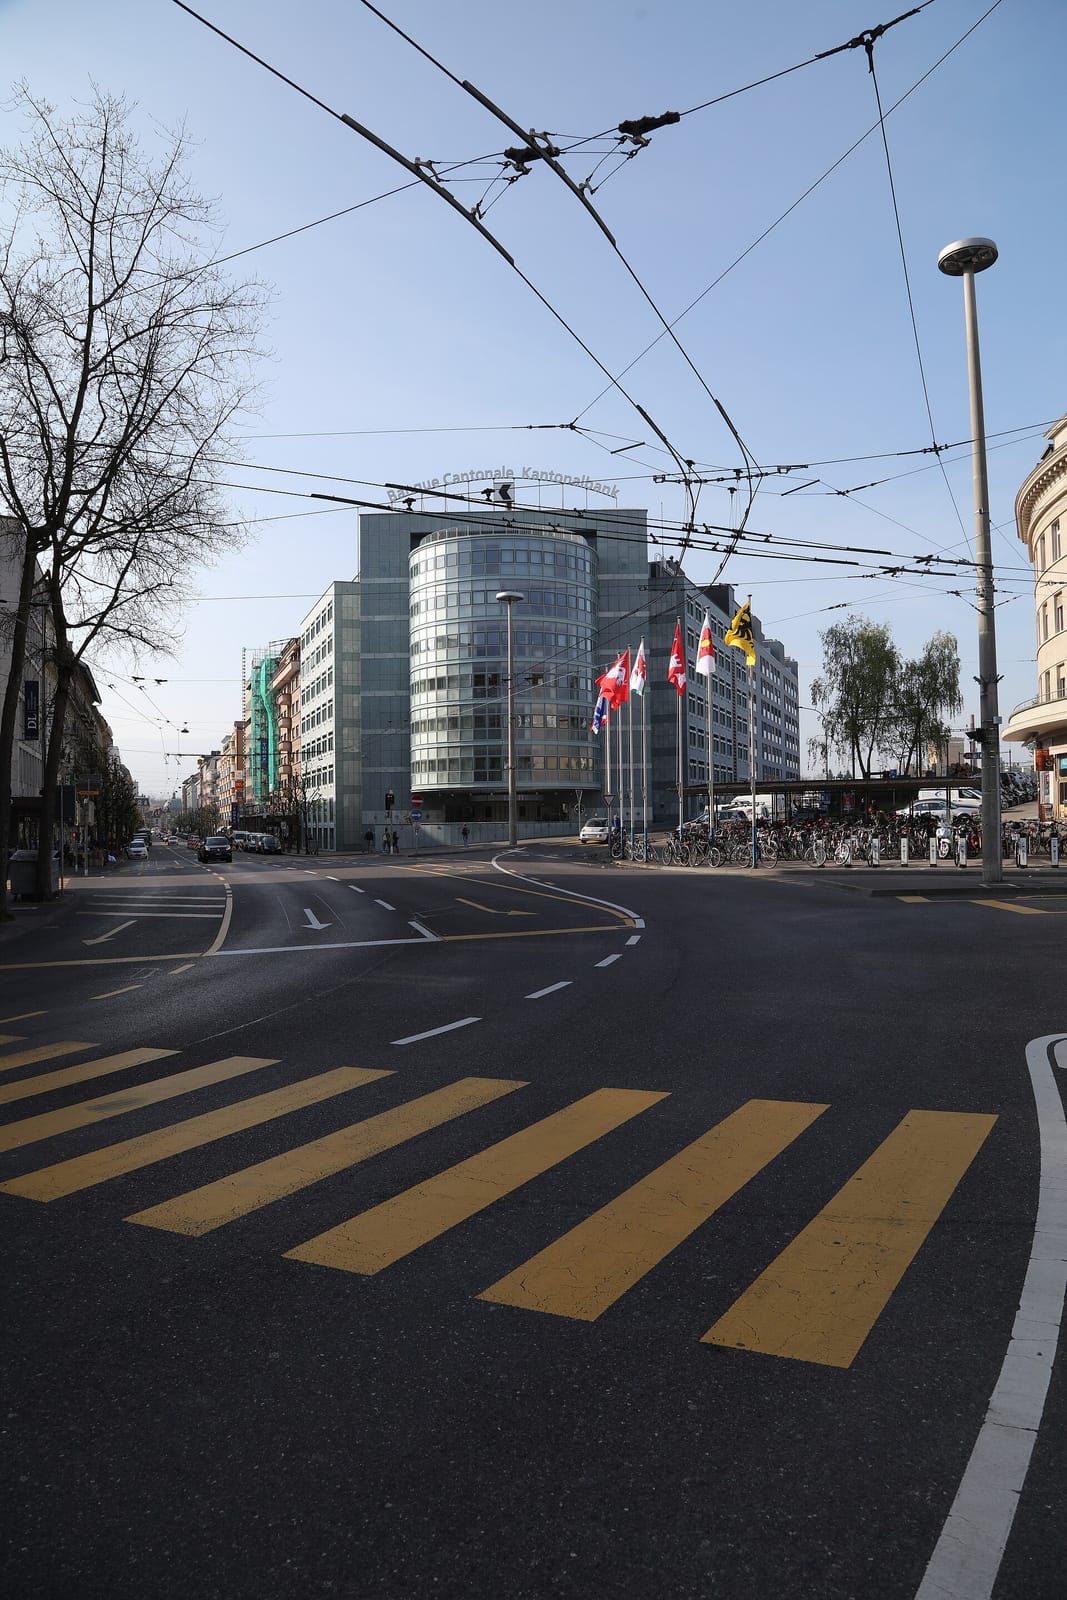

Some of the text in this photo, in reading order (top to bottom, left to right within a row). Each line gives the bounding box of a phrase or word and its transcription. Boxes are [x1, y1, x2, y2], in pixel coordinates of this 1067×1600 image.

[386, 465, 620, 501] Baque Cantonale Kantonalbank
